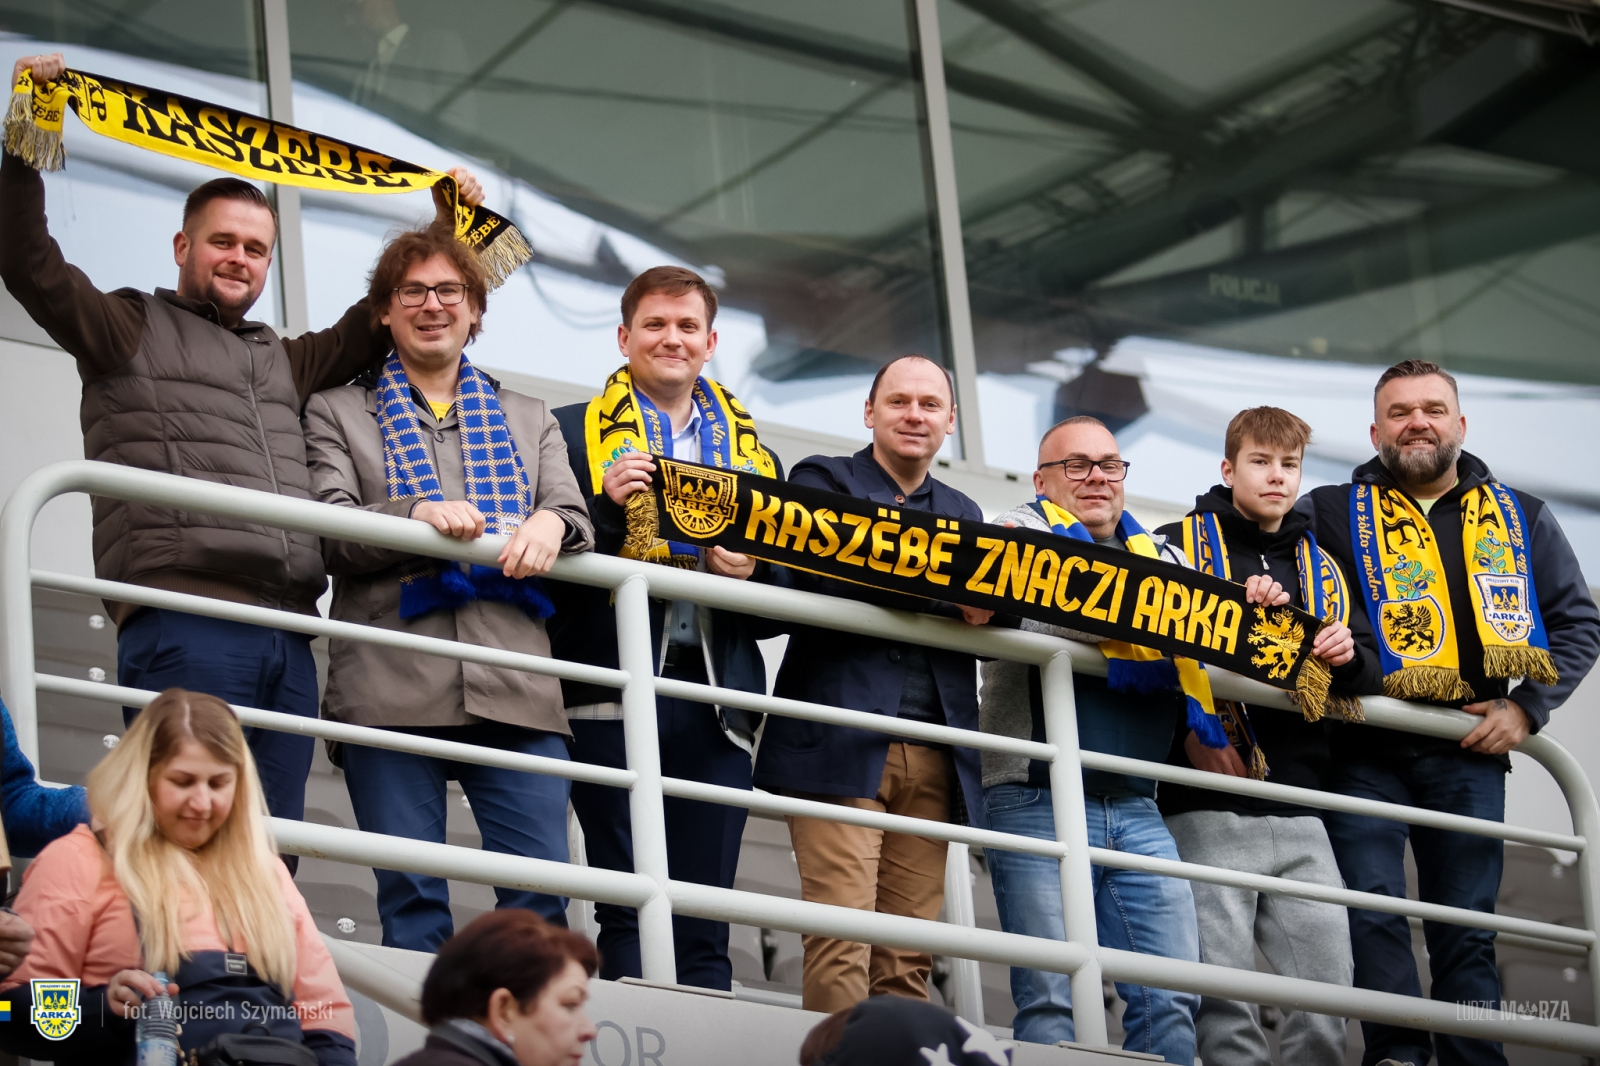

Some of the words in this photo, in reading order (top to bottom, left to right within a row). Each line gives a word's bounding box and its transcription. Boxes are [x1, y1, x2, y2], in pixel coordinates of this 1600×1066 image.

[674, 499, 723, 515] ARKA
[744, 488, 961, 586] KASZËBË
[965, 537, 1130, 624] ZNACZI
[1132, 576, 1243, 656] ARKA
[1492, 612, 1526, 622] ARKA
